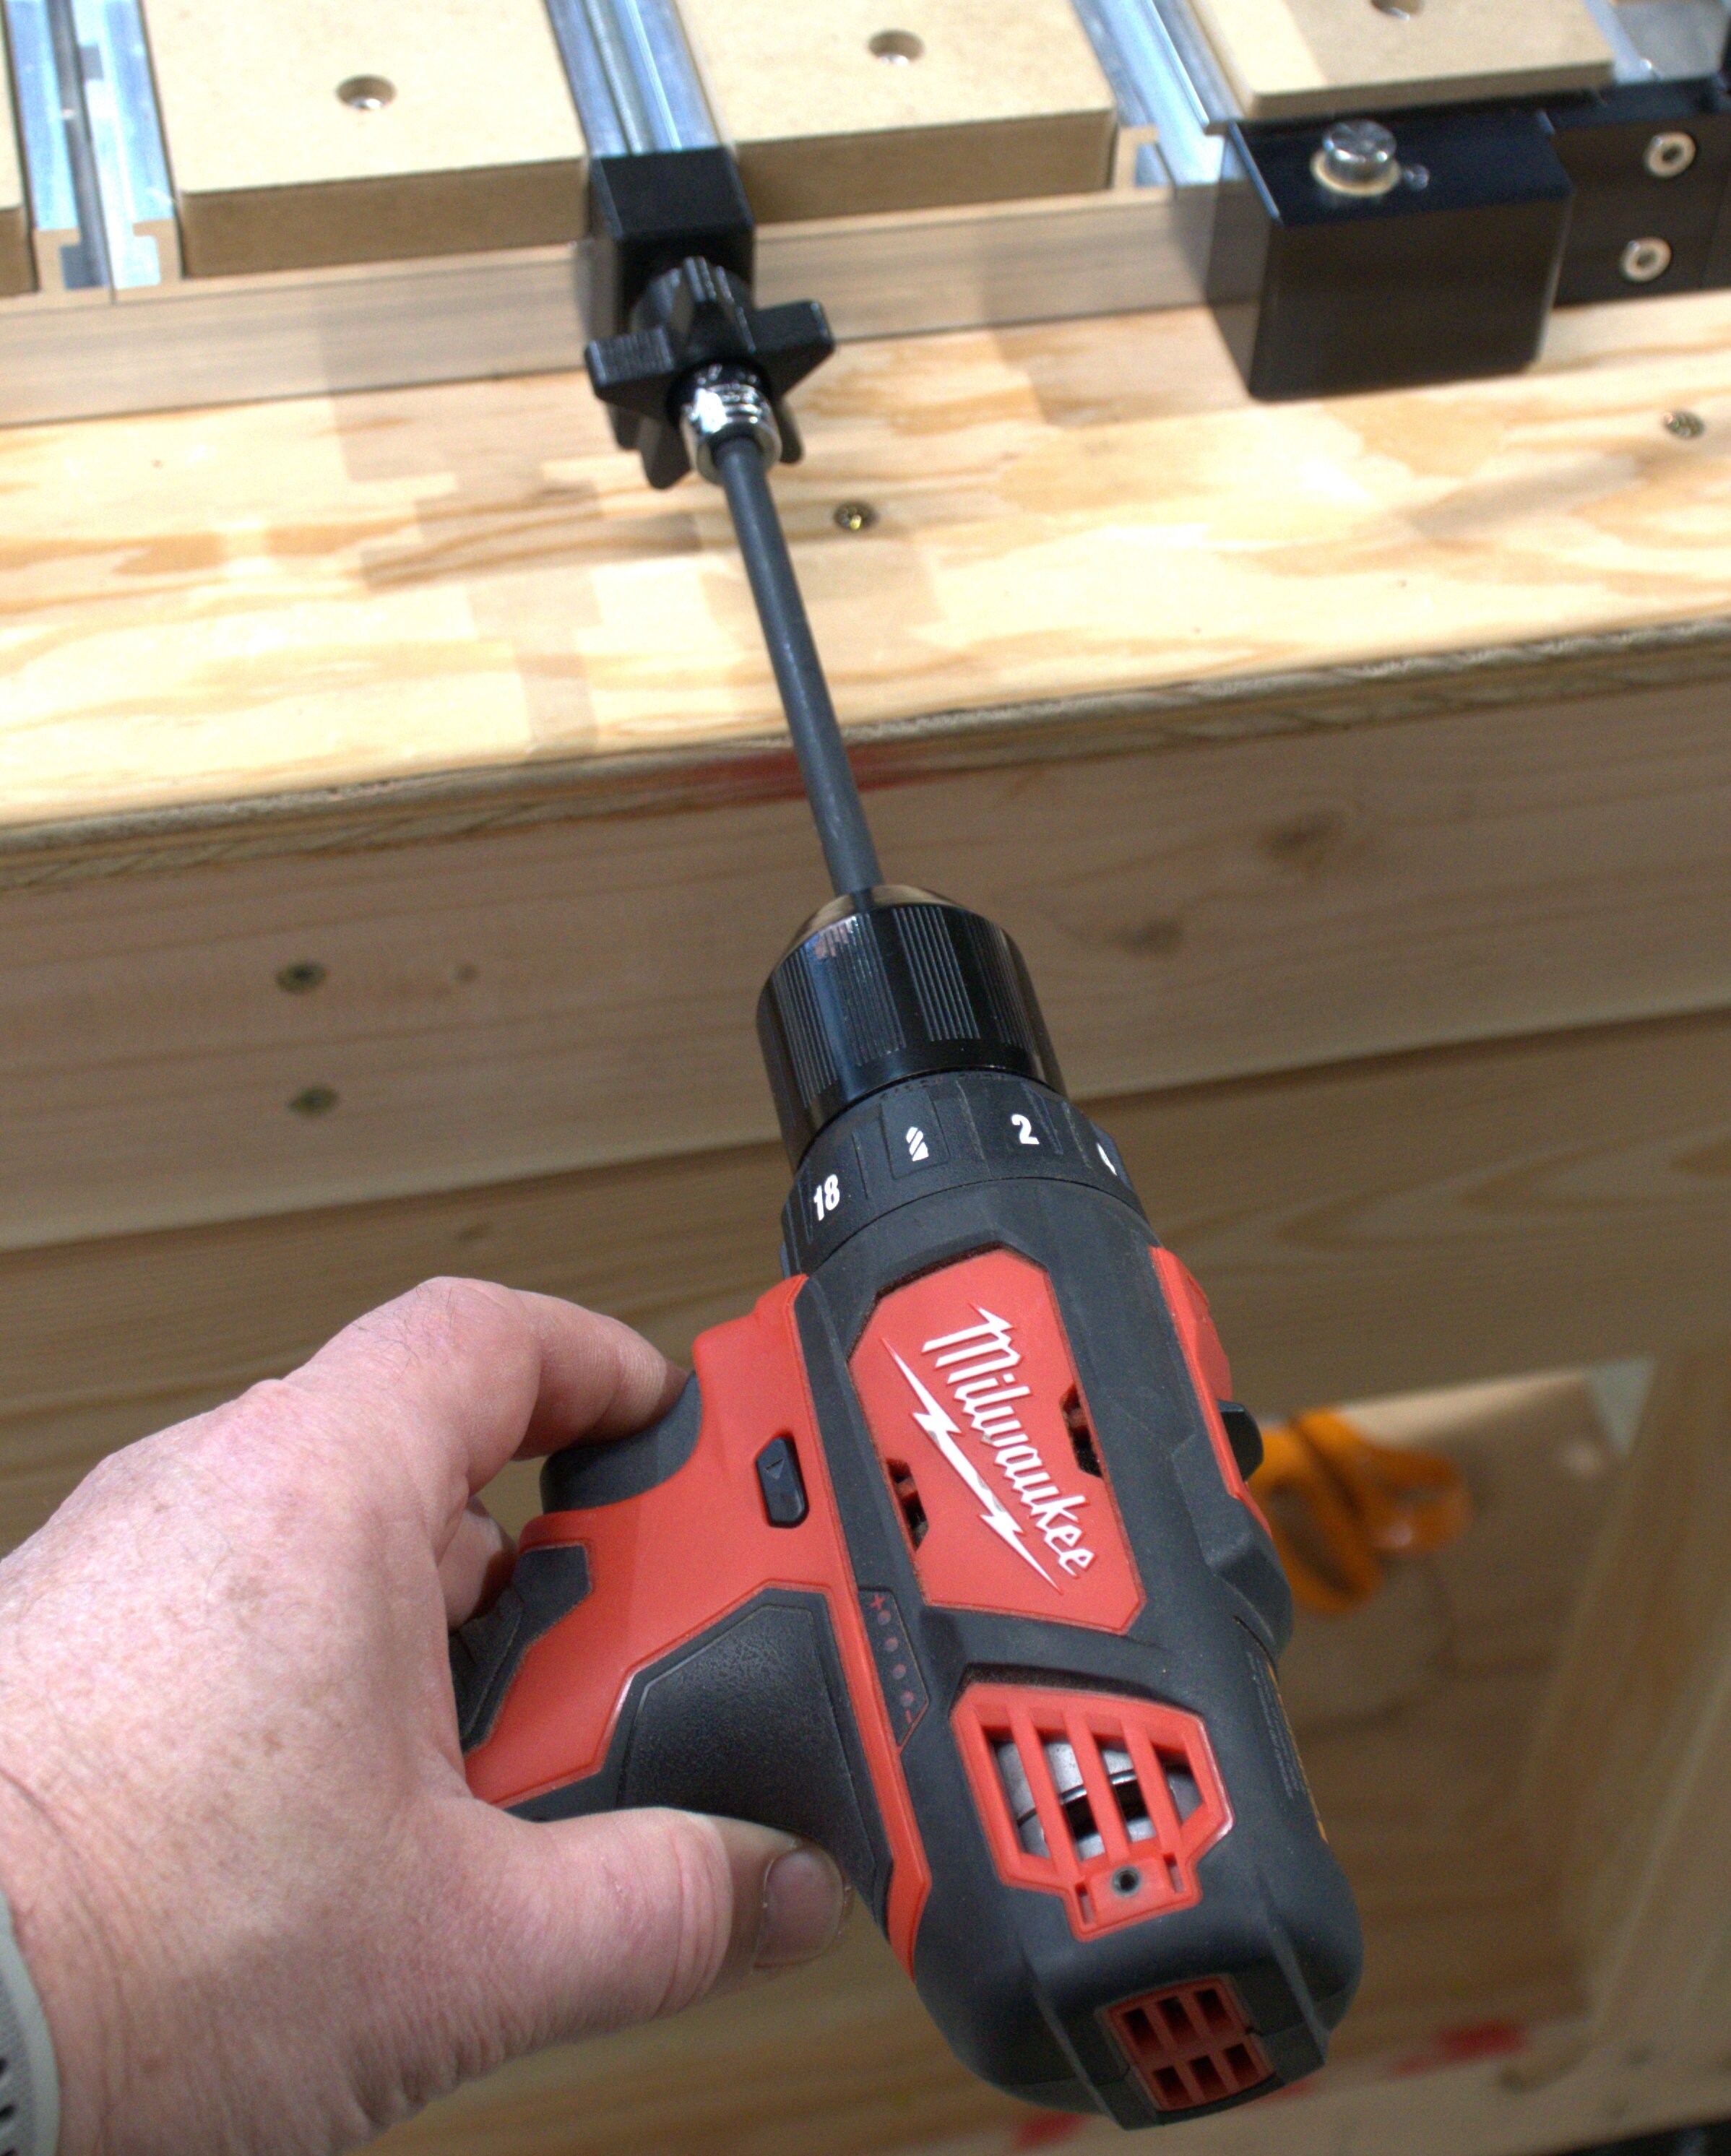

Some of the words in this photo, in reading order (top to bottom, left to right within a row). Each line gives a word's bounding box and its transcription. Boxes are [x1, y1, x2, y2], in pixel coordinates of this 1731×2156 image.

[1011, 1114, 1040, 1145] 2
[813, 1174, 840, 1221] 18
[921, 1304, 1095, 1577] Milwaukee
